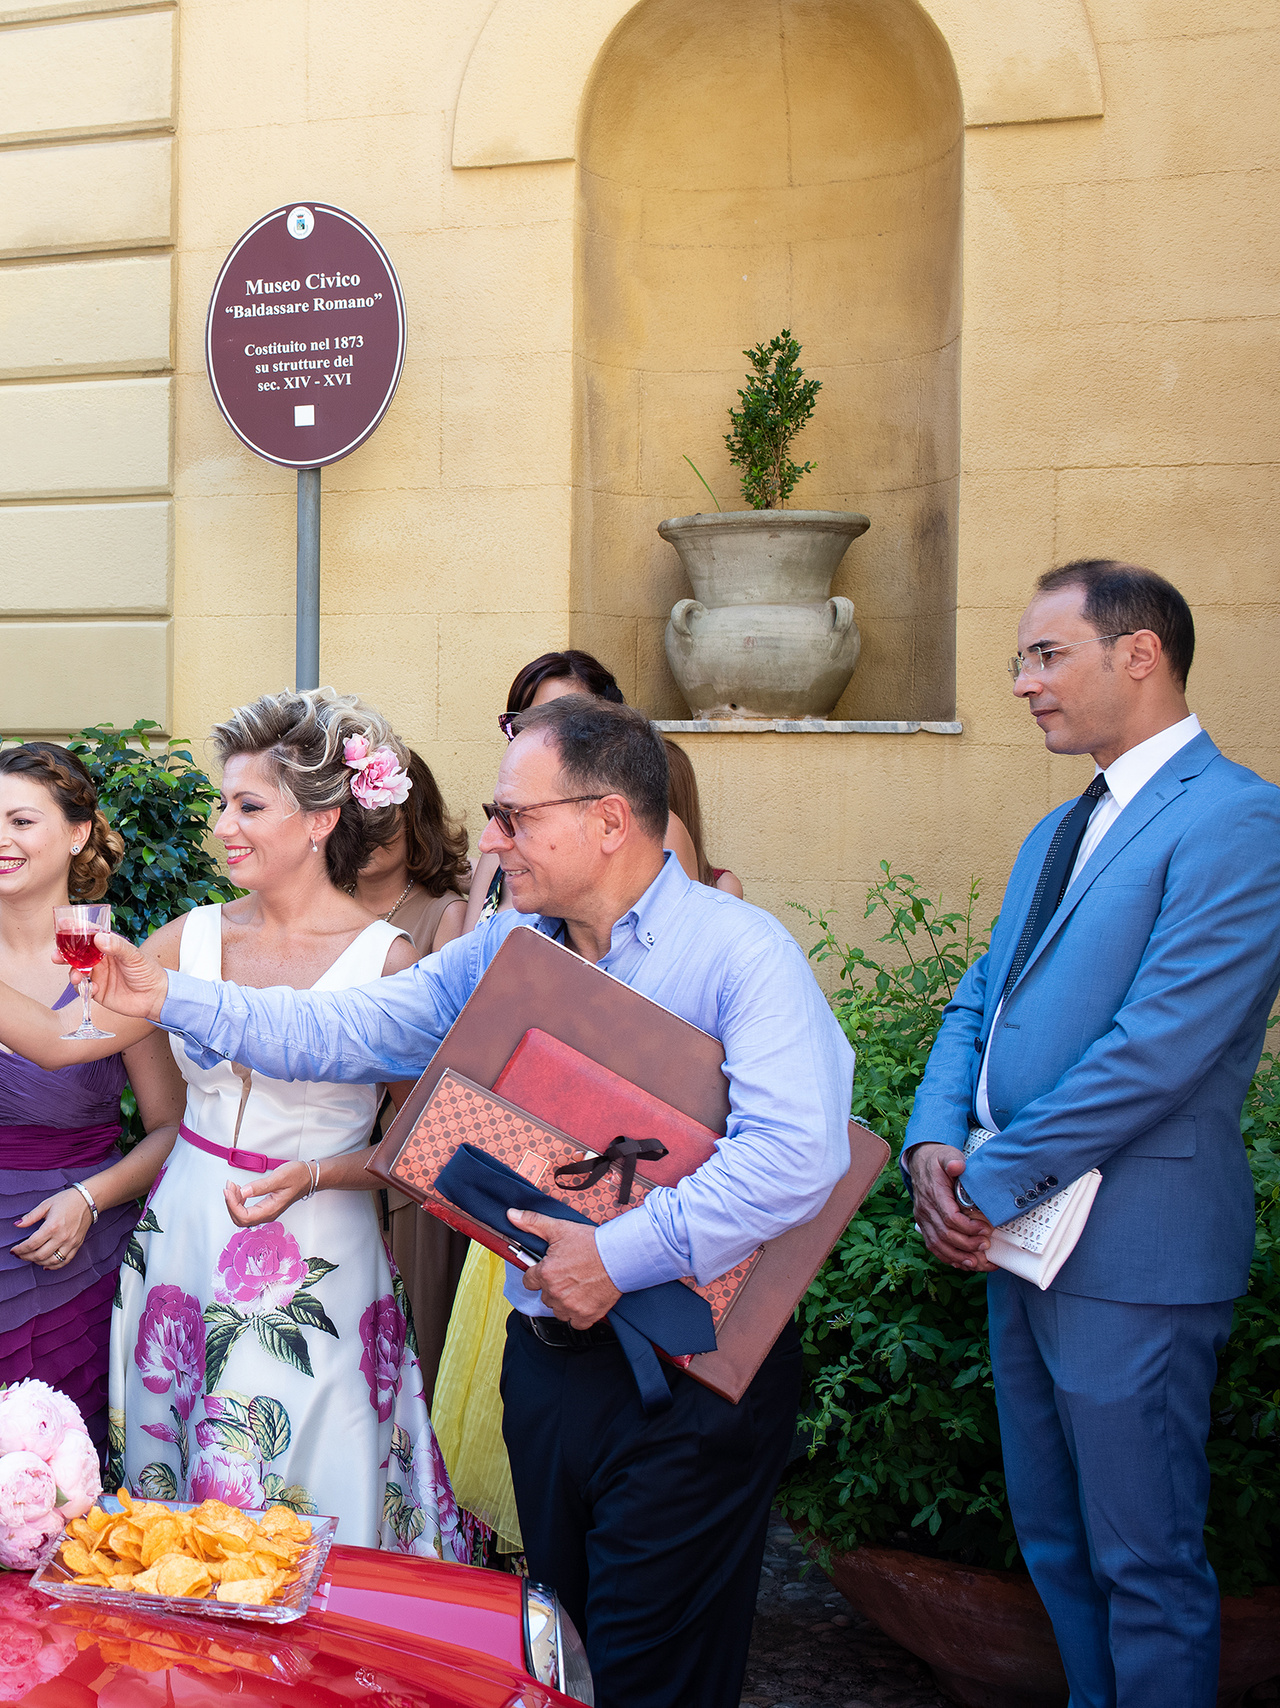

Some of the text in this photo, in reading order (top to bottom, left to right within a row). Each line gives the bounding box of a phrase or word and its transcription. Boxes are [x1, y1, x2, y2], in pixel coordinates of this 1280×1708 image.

[246, 272, 361, 296] Museo Civico
[225, 293, 383, 319] “Baldassare Romano”
[244, 335, 364, 357] Costituito nel 1873
[255, 355, 354, 374] su strutture del
[257, 379, 280, 392] sec.
[283, 375, 311, 390] XIV
[323, 373, 352, 387] XVI
